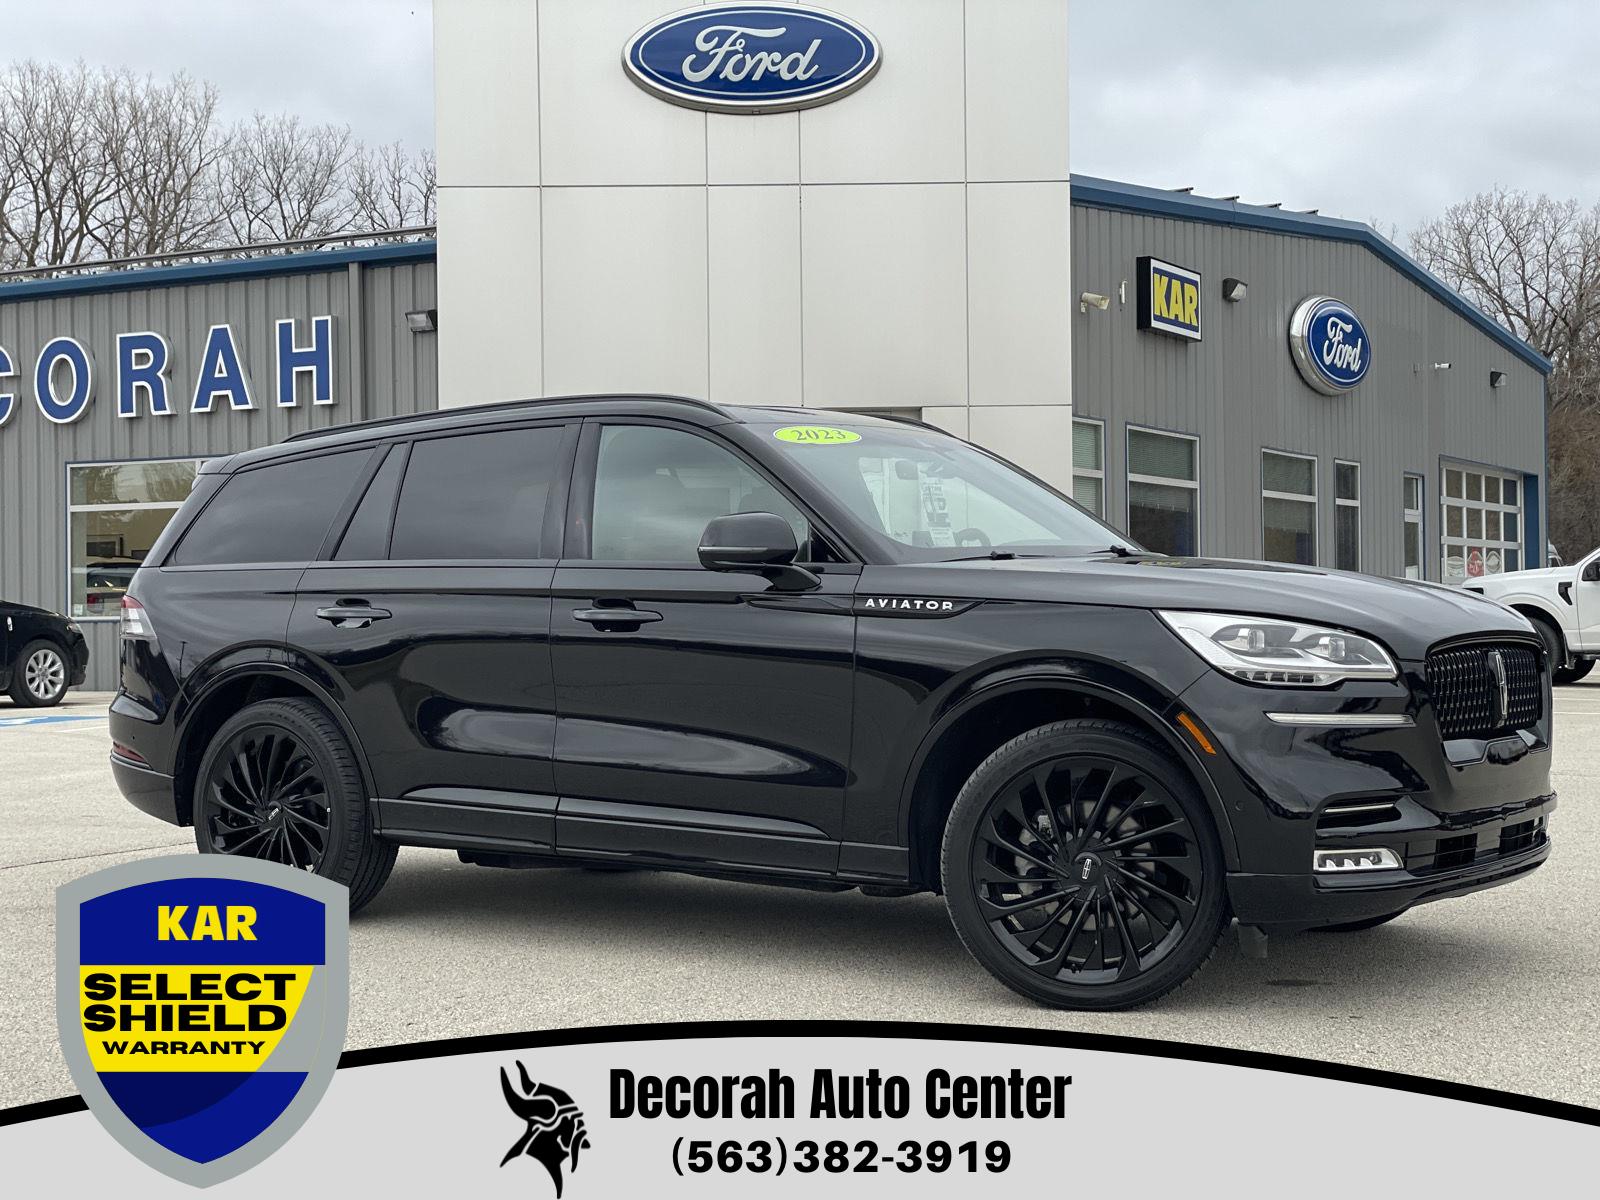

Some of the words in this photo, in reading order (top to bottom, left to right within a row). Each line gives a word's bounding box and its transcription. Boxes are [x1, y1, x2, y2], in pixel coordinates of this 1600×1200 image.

[681, 25, 822, 83] Ford
[1153, 273, 1198, 327] KAR
[1322, 316, 1362, 373] Ford
[791, 429, 846, 441] 2023
[865, 599, 952, 610] AVIATOR
